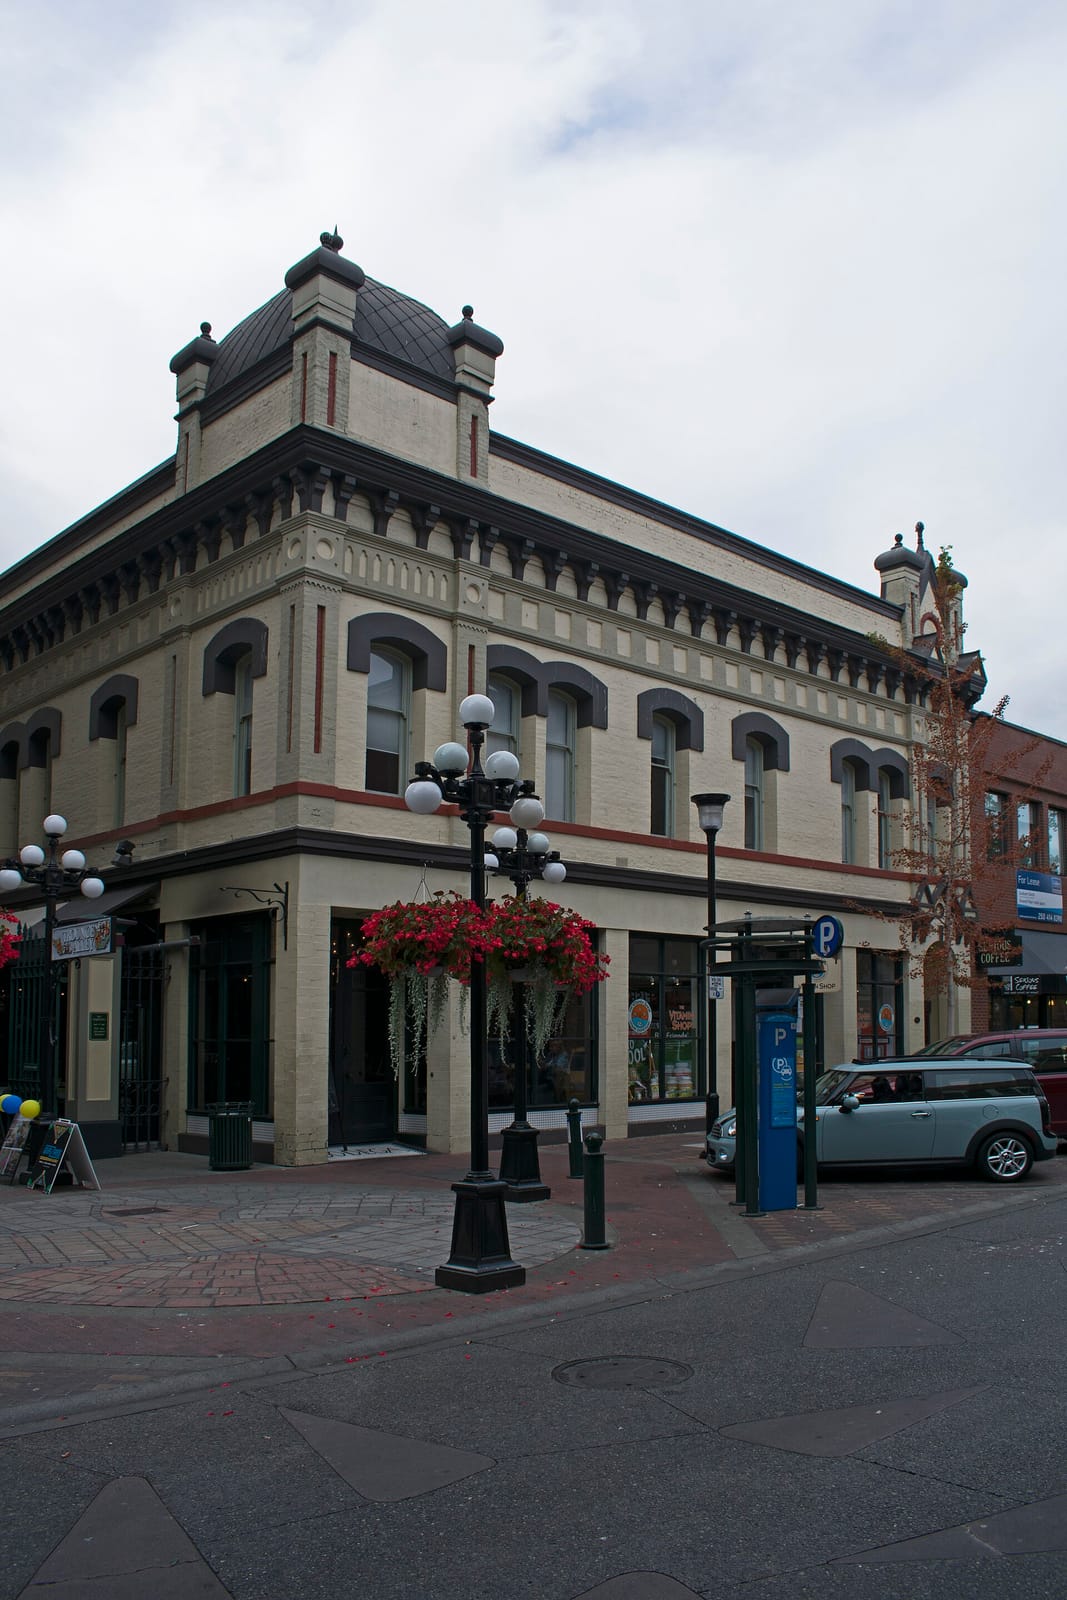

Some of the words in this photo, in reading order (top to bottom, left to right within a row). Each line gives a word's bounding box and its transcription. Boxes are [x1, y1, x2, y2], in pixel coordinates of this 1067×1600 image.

[1018, 875, 1026, 884] For
[1027, 877, 1040, 887] Lease
[820, 921, 835, 953] P
[980, 952, 1010, 964] COFFEE
[669, 1009, 695, 1021] VITAMIN
[672, 1021, 692, 1031] SHOP
[775, 1028, 786, 1046] P
[777, 1058, 784, 1070] P
